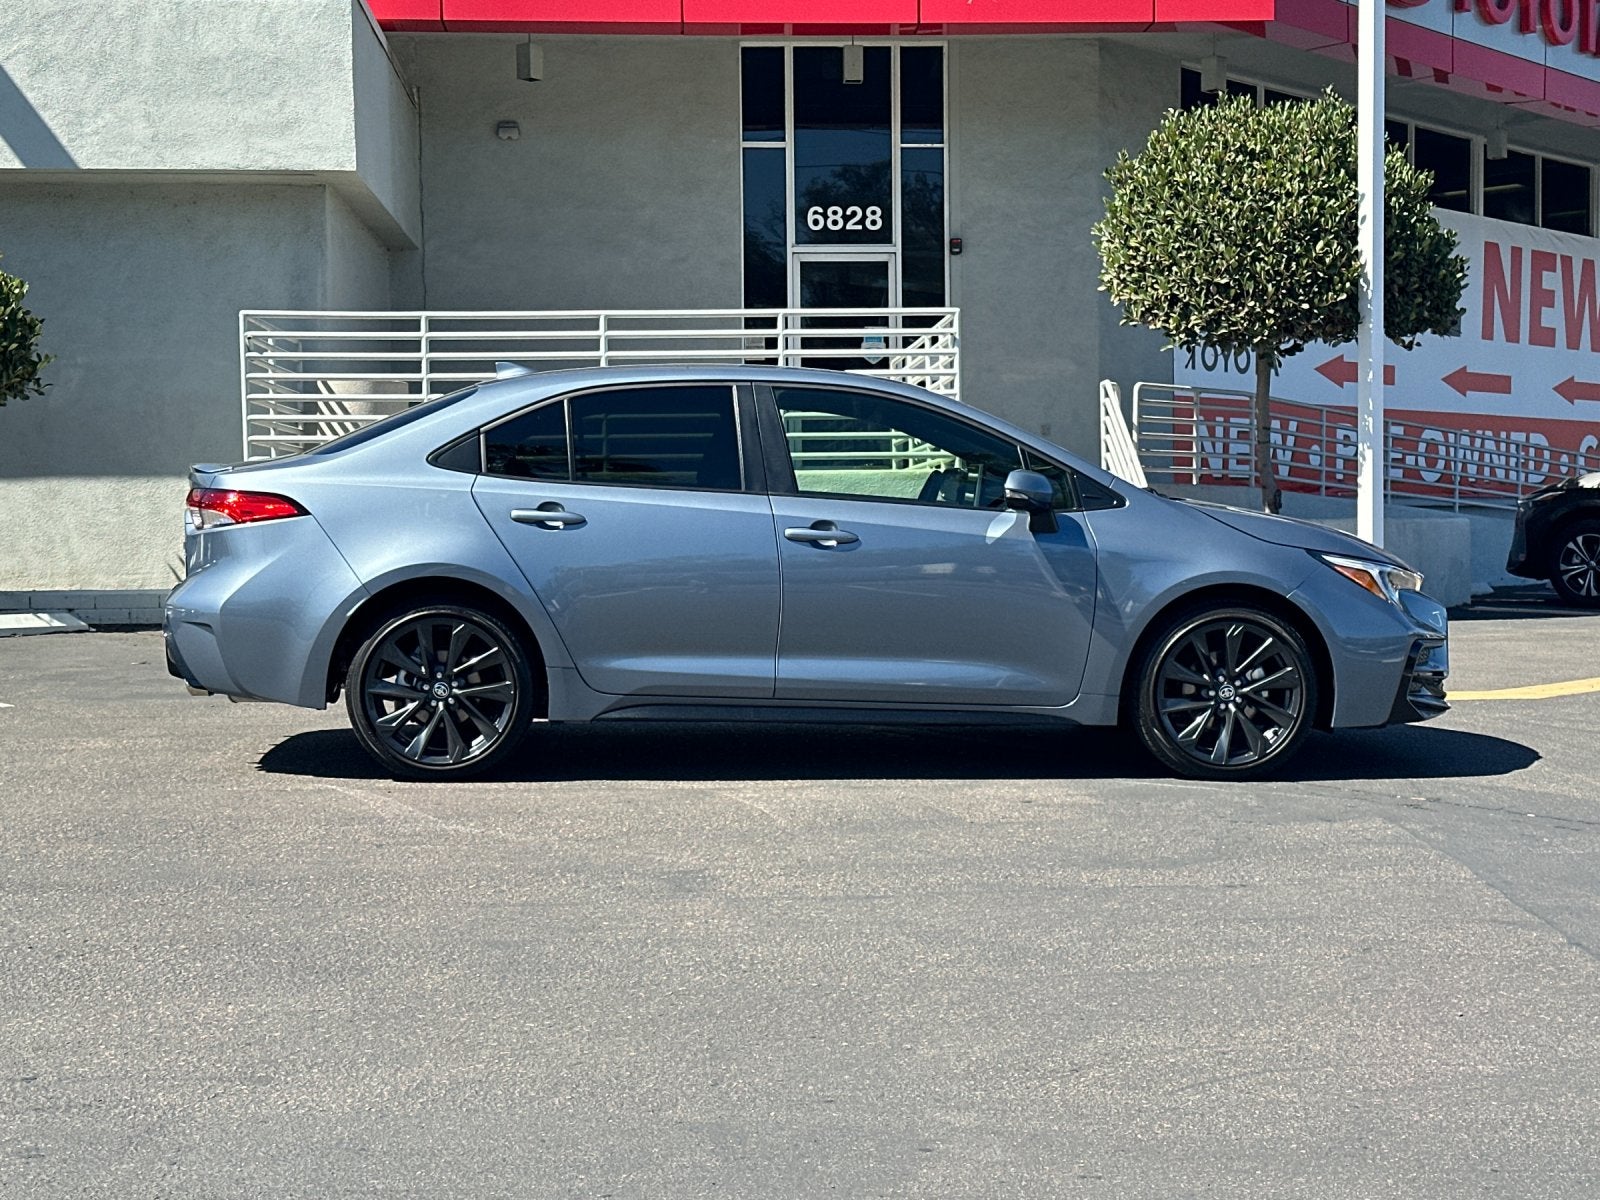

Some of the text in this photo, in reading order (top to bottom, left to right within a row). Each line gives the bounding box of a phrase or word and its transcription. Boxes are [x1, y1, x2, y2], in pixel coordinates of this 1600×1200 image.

[807, 205, 883, 231] 6828
[1481, 241, 1600, 353] NEW
[1336, 423, 1550, 483] PE-OWNED
